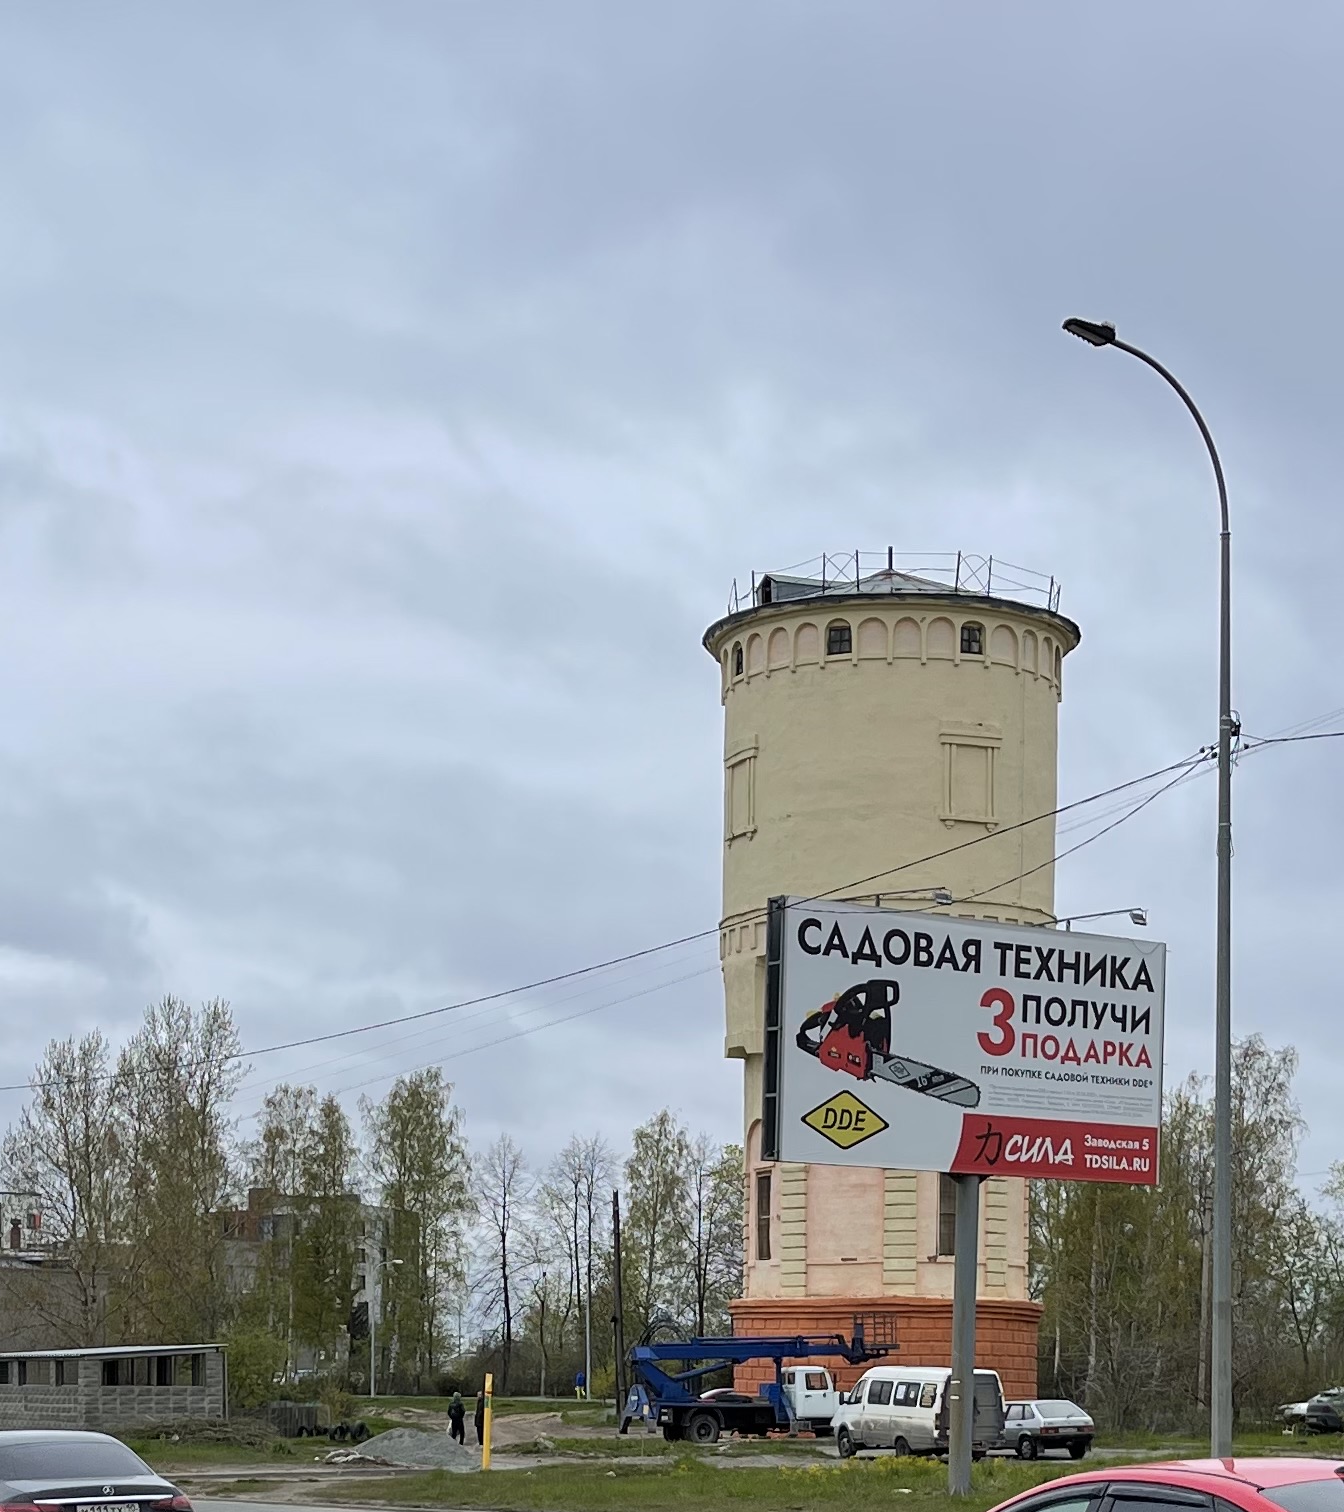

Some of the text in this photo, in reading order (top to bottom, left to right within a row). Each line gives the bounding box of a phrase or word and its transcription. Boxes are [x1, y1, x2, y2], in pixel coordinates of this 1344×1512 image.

[798, 918, 1155, 993] САДОВАЯ ТЕХНИКА
[977, 987, 1016, 1057] 3
[1021, 994, 1151, 1035] ПОЛУЧИ
[1021, 1033, 1153, 1069] ПОДАРКА
[980, 1065, 999, 1076] ПРИ
[1001, 1067, 1043, 1080] ПОКУПКЕ
[1044, 1071, 1089, 1084] САДОВОЙ
[1091, 1074, 1130, 1087] ТЕХНИКИ
[821, 1107, 868, 1132] DDE
[1004, 1134, 1075, 1166] СИЛА
[1084, 1134, 1150, 1151] Заводская 5
[1084, 1154, 1150, 1172] TDSILA.RU
